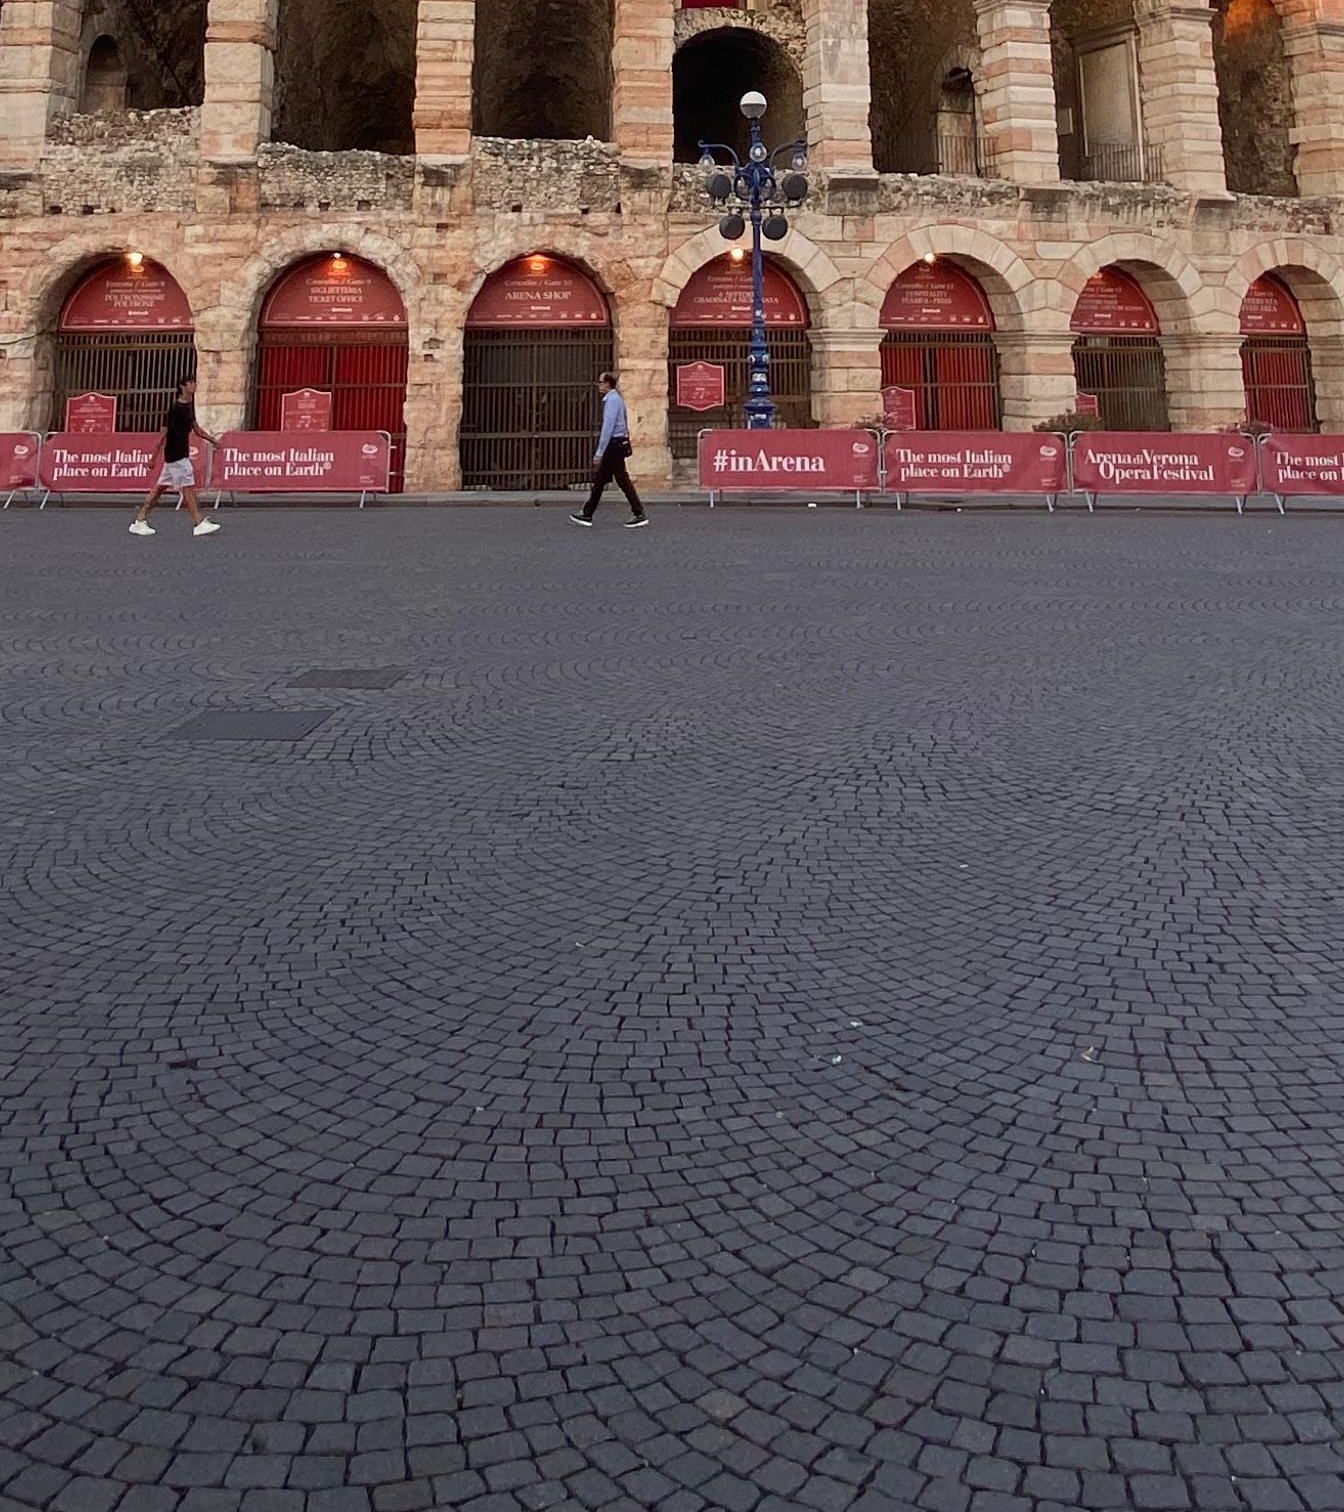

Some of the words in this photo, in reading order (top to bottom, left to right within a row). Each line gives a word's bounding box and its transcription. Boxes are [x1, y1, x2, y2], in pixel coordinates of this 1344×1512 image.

[504, 291, 541, 300] ARENA
[542, 291, 572, 300] SHOP
[53, 449, 80, 464] The
[81, 451, 113, 463] most
[224, 448, 251, 462] The
[253, 449, 286, 463] most
[289, 448, 334, 463] Italian
[713, 449, 826, 473] #inArena
[897, 449, 925, 464] The
[928, 451, 962, 464] most
[966, 449, 1013, 465] Italian
[1275, 451, 1302, 466] The
[1305, 454, 1339, 467] most
[53, 463, 89, 481] place
[91, 467, 109, 478] on
[224, 462, 262, 479] place
[264, 465, 282, 476] on
[900, 464, 939, 481] place
[941, 467, 959, 478] on
[1278, 467, 1318, 483] place
[1319, 470, 1337, 480] on
